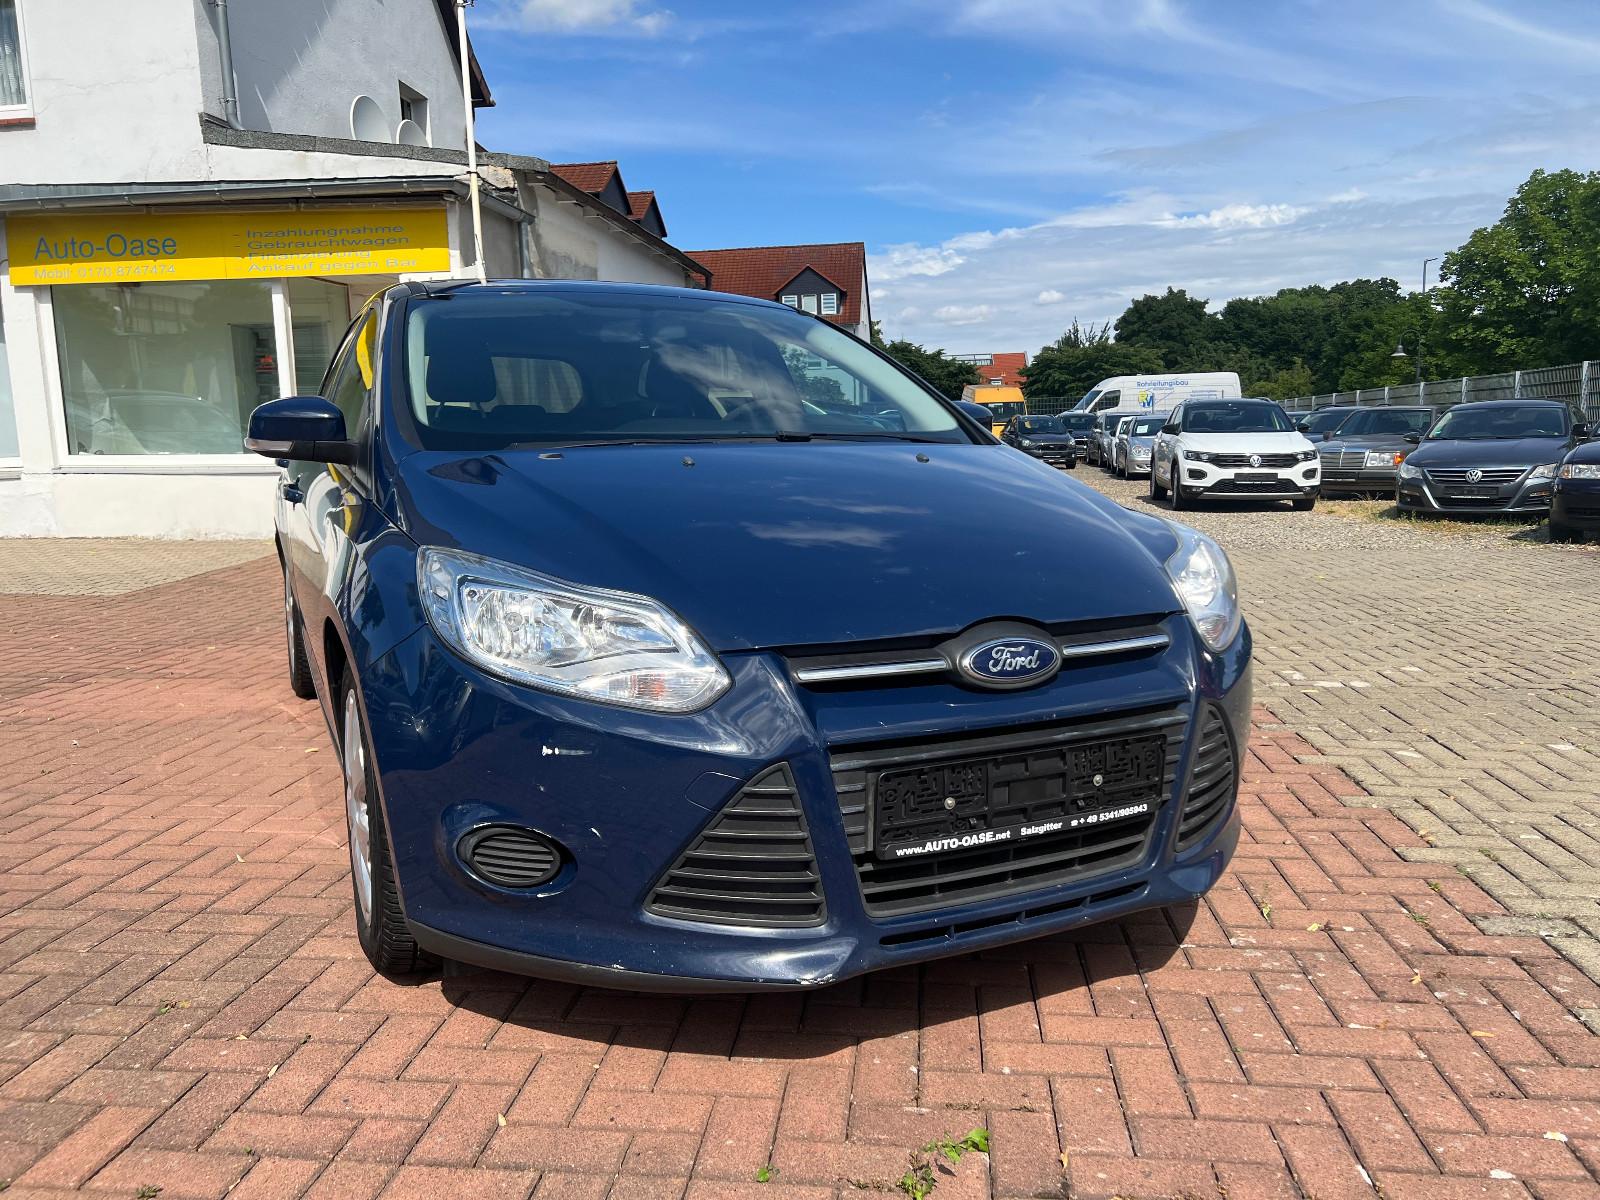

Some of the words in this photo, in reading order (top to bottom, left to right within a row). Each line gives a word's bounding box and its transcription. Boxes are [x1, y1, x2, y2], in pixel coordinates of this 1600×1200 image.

[246, 225, 405, 238] Inzahlungnahme
[34, 233, 178, 260] Auto-Oase
[247, 236, 409, 250] Gebrauchtwagen
[116, 263, 176, 275] 8747474
[248, 262, 314, 272] Ankauf
[319, 262, 378, 272] gegen
[385, 258, 417, 267] Bar
[1136, 380, 1189, 388] Rohrleitungsbau
[988, 645, 1040, 673] Ford
[896, 830, 1011, 857] www.AUTO-OASE.net
[1020, 821, 1063, 837] Salzgitter
[1086, 814, 1098, 824] 49
[1098, 803, 1148, 822] 5341/905943
